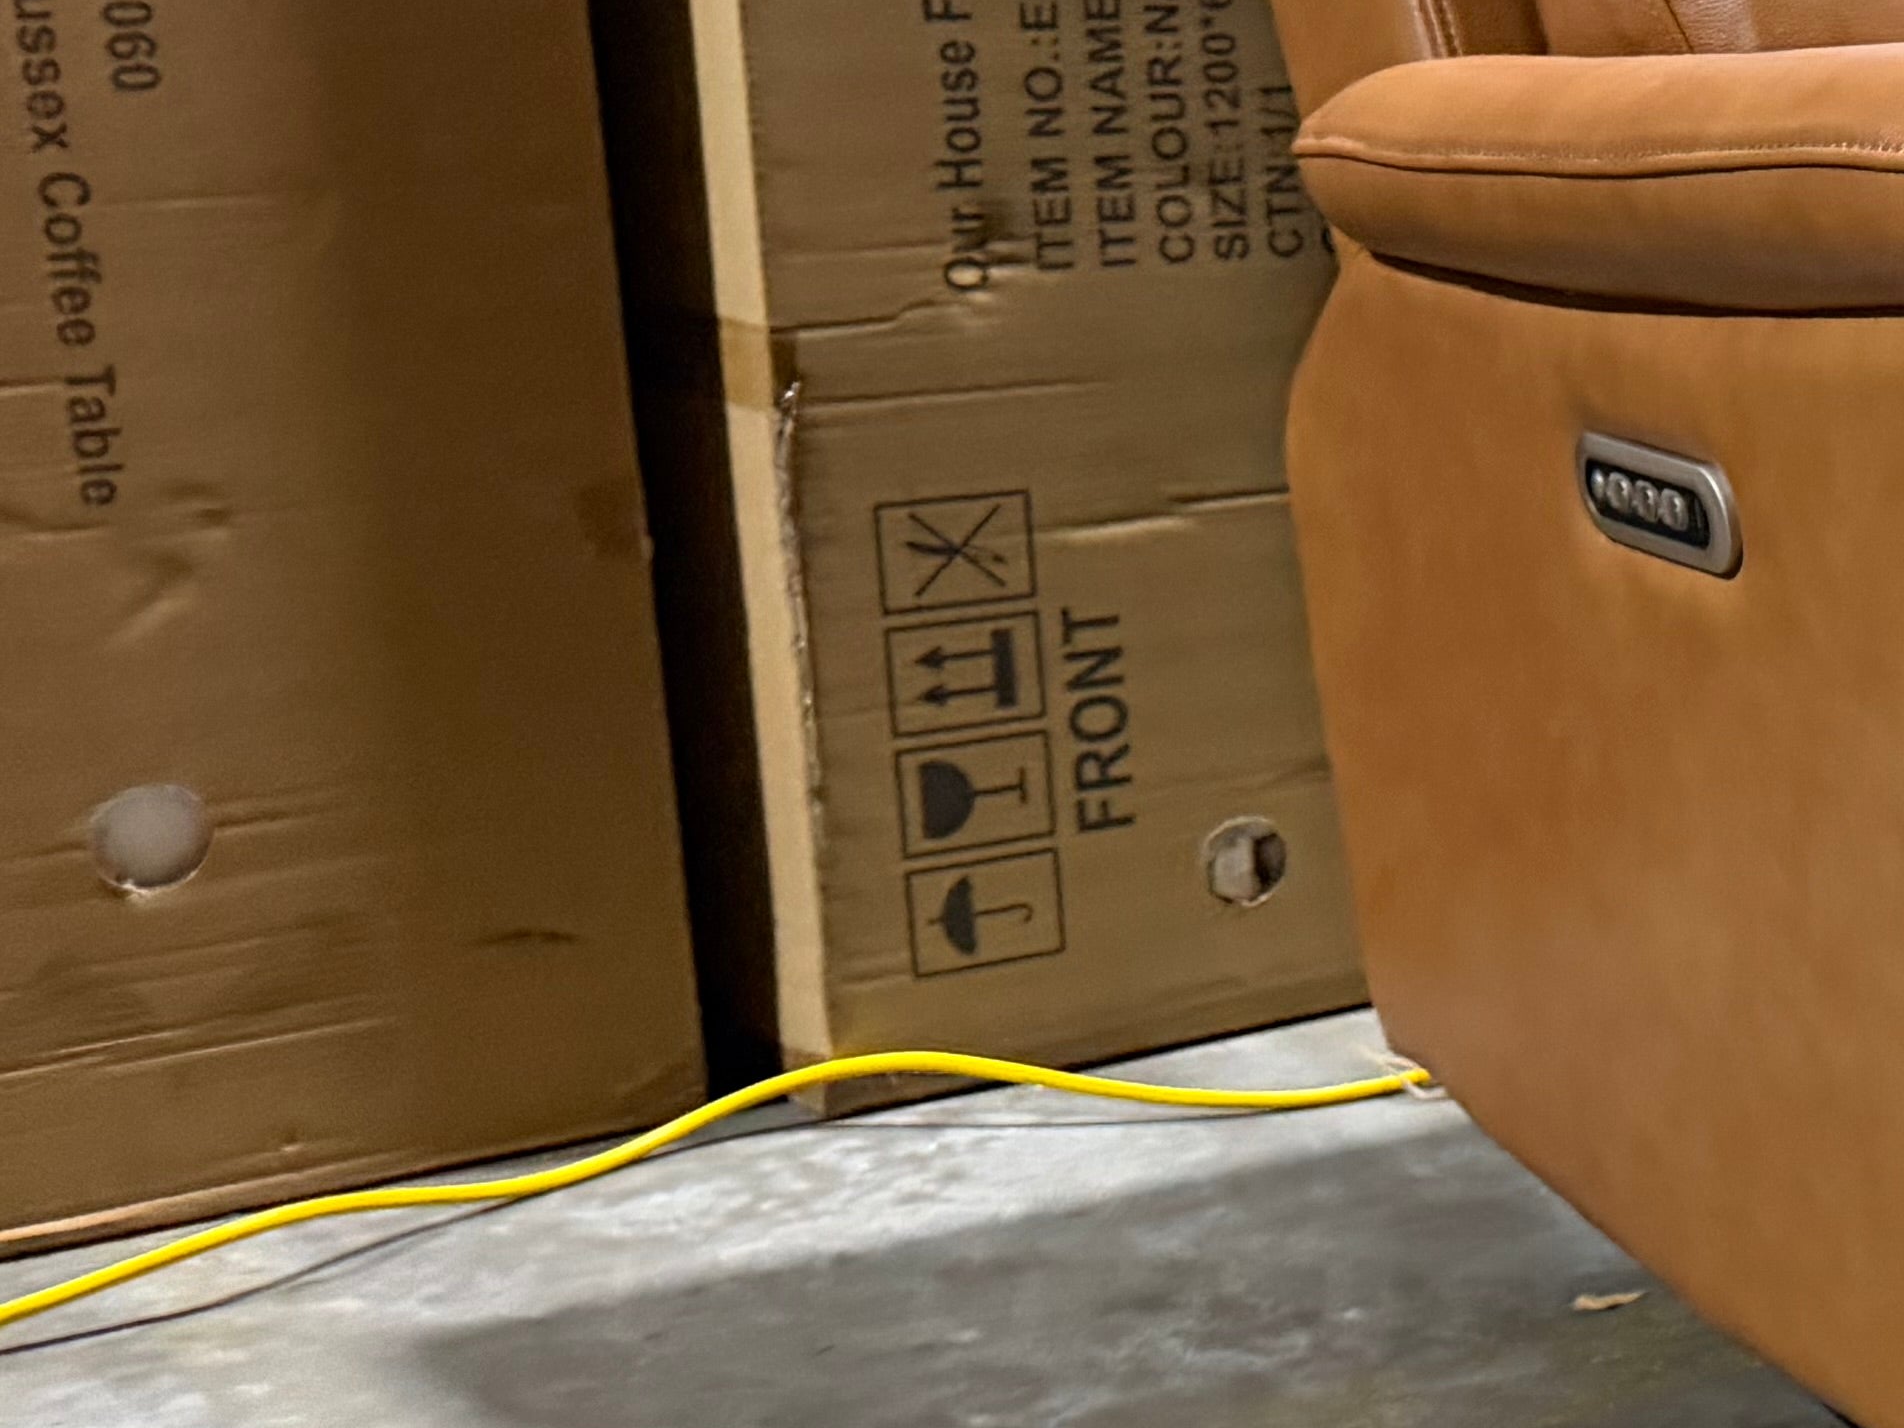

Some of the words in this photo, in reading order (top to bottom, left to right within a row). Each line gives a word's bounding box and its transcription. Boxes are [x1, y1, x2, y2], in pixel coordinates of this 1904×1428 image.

[935, 40, 983, 191] House
[38, 172, 104, 349] Coffee
[944, 206, 988, 294] Our
[1030, 157, 1074, 271] ITEM
[1095, 155, 1137, 267] ITEM
[66, 367, 127, 508] Table
[1060, 606, 1134, 835] FRONT
